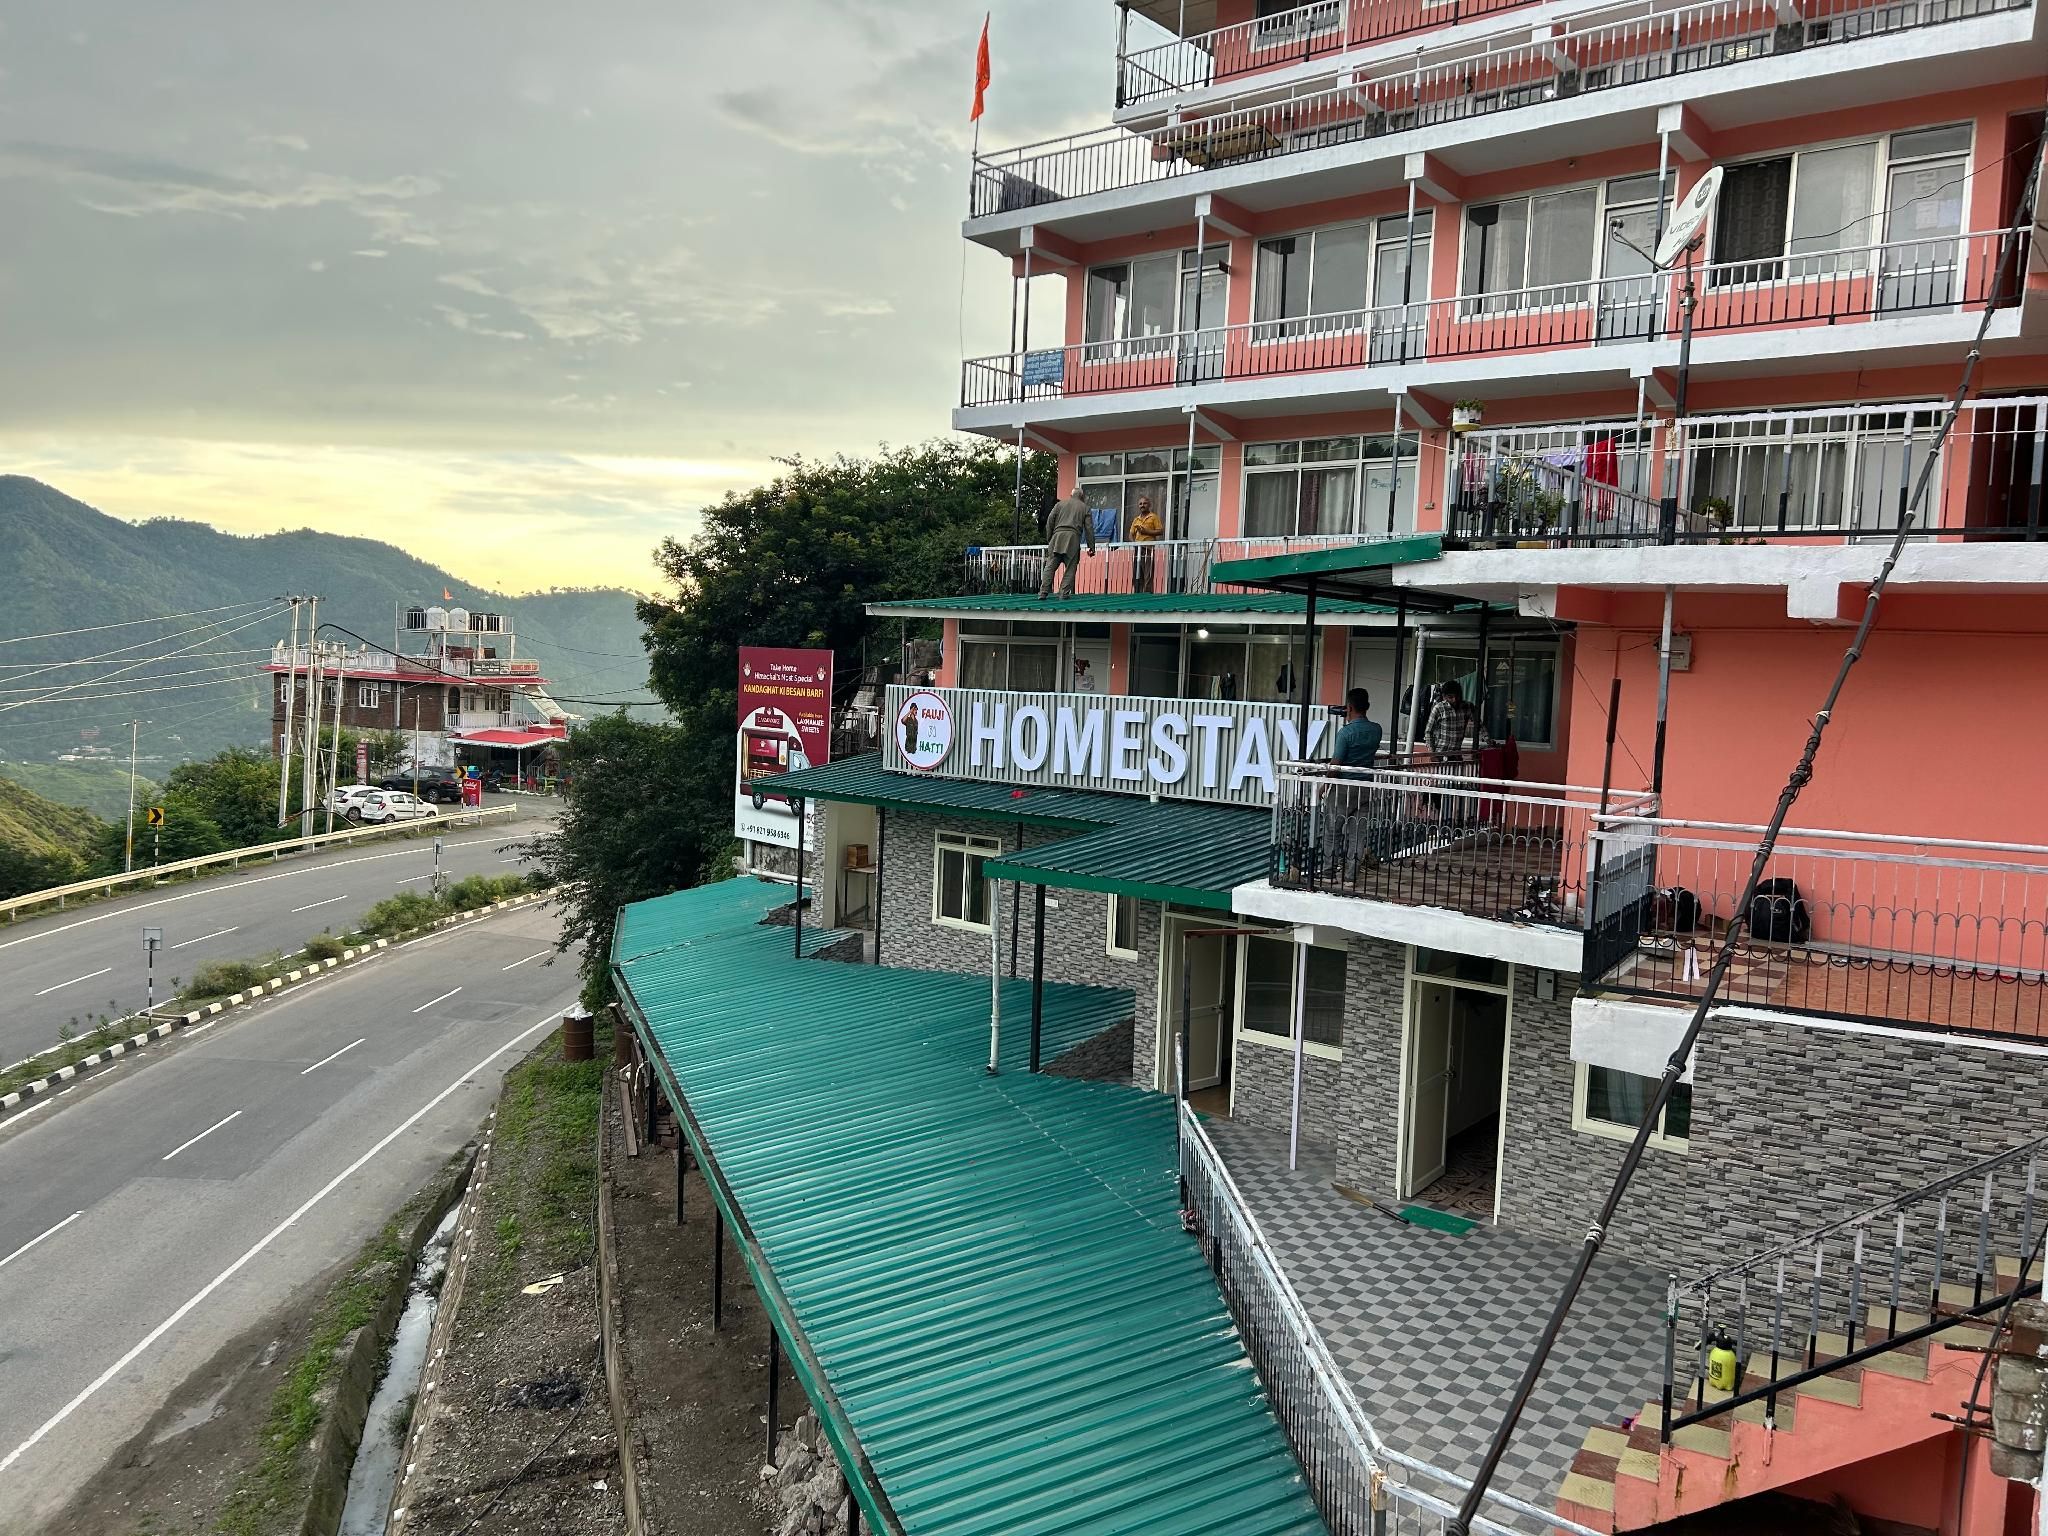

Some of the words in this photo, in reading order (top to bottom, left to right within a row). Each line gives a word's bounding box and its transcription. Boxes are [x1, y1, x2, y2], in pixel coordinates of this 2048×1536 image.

[782, 664, 797, 672] Home
[781, 674, 794, 682] Most
[794, 675, 813, 683] Special
[743, 684, 779, 694] KANDAGHAT
[786, 687, 806, 697] BESAN
[806, 688, 824, 698] BARFI
[922, 708, 945, 721] FAUJI
[919, 740, 944, 755] HATTI
[970, 701, 1330, 793] HOMESTAY
